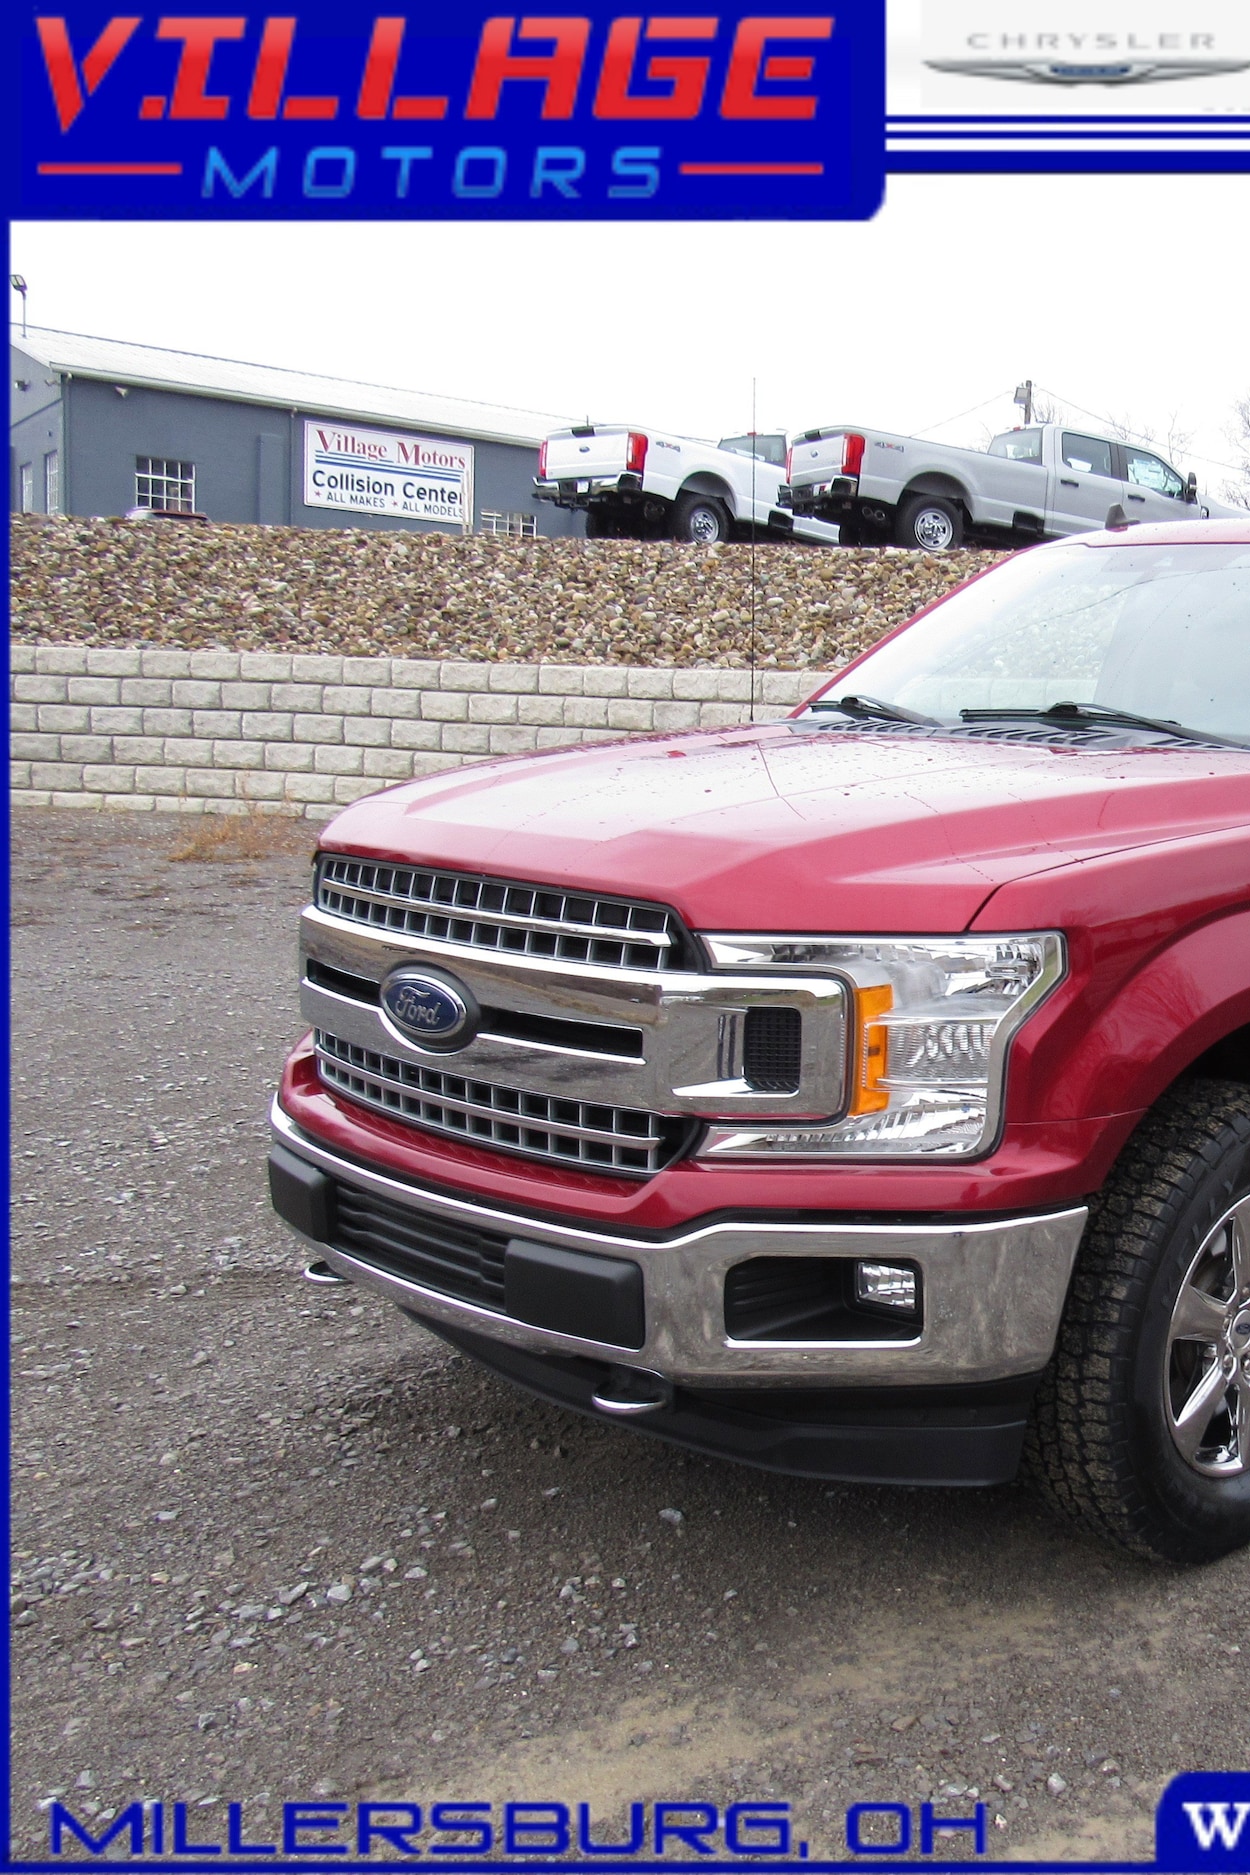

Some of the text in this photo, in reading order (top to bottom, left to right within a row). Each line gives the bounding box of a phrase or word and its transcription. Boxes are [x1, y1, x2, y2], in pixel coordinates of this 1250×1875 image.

[316, 429, 466, 469] Village Motors
[313, 470, 394, 496] Collision
[327, 492, 346, 503] ALL
[350, 495, 386, 508] MAKES
[402, 501, 420, 512] ALL
[396, 986, 442, 1025] Ford
